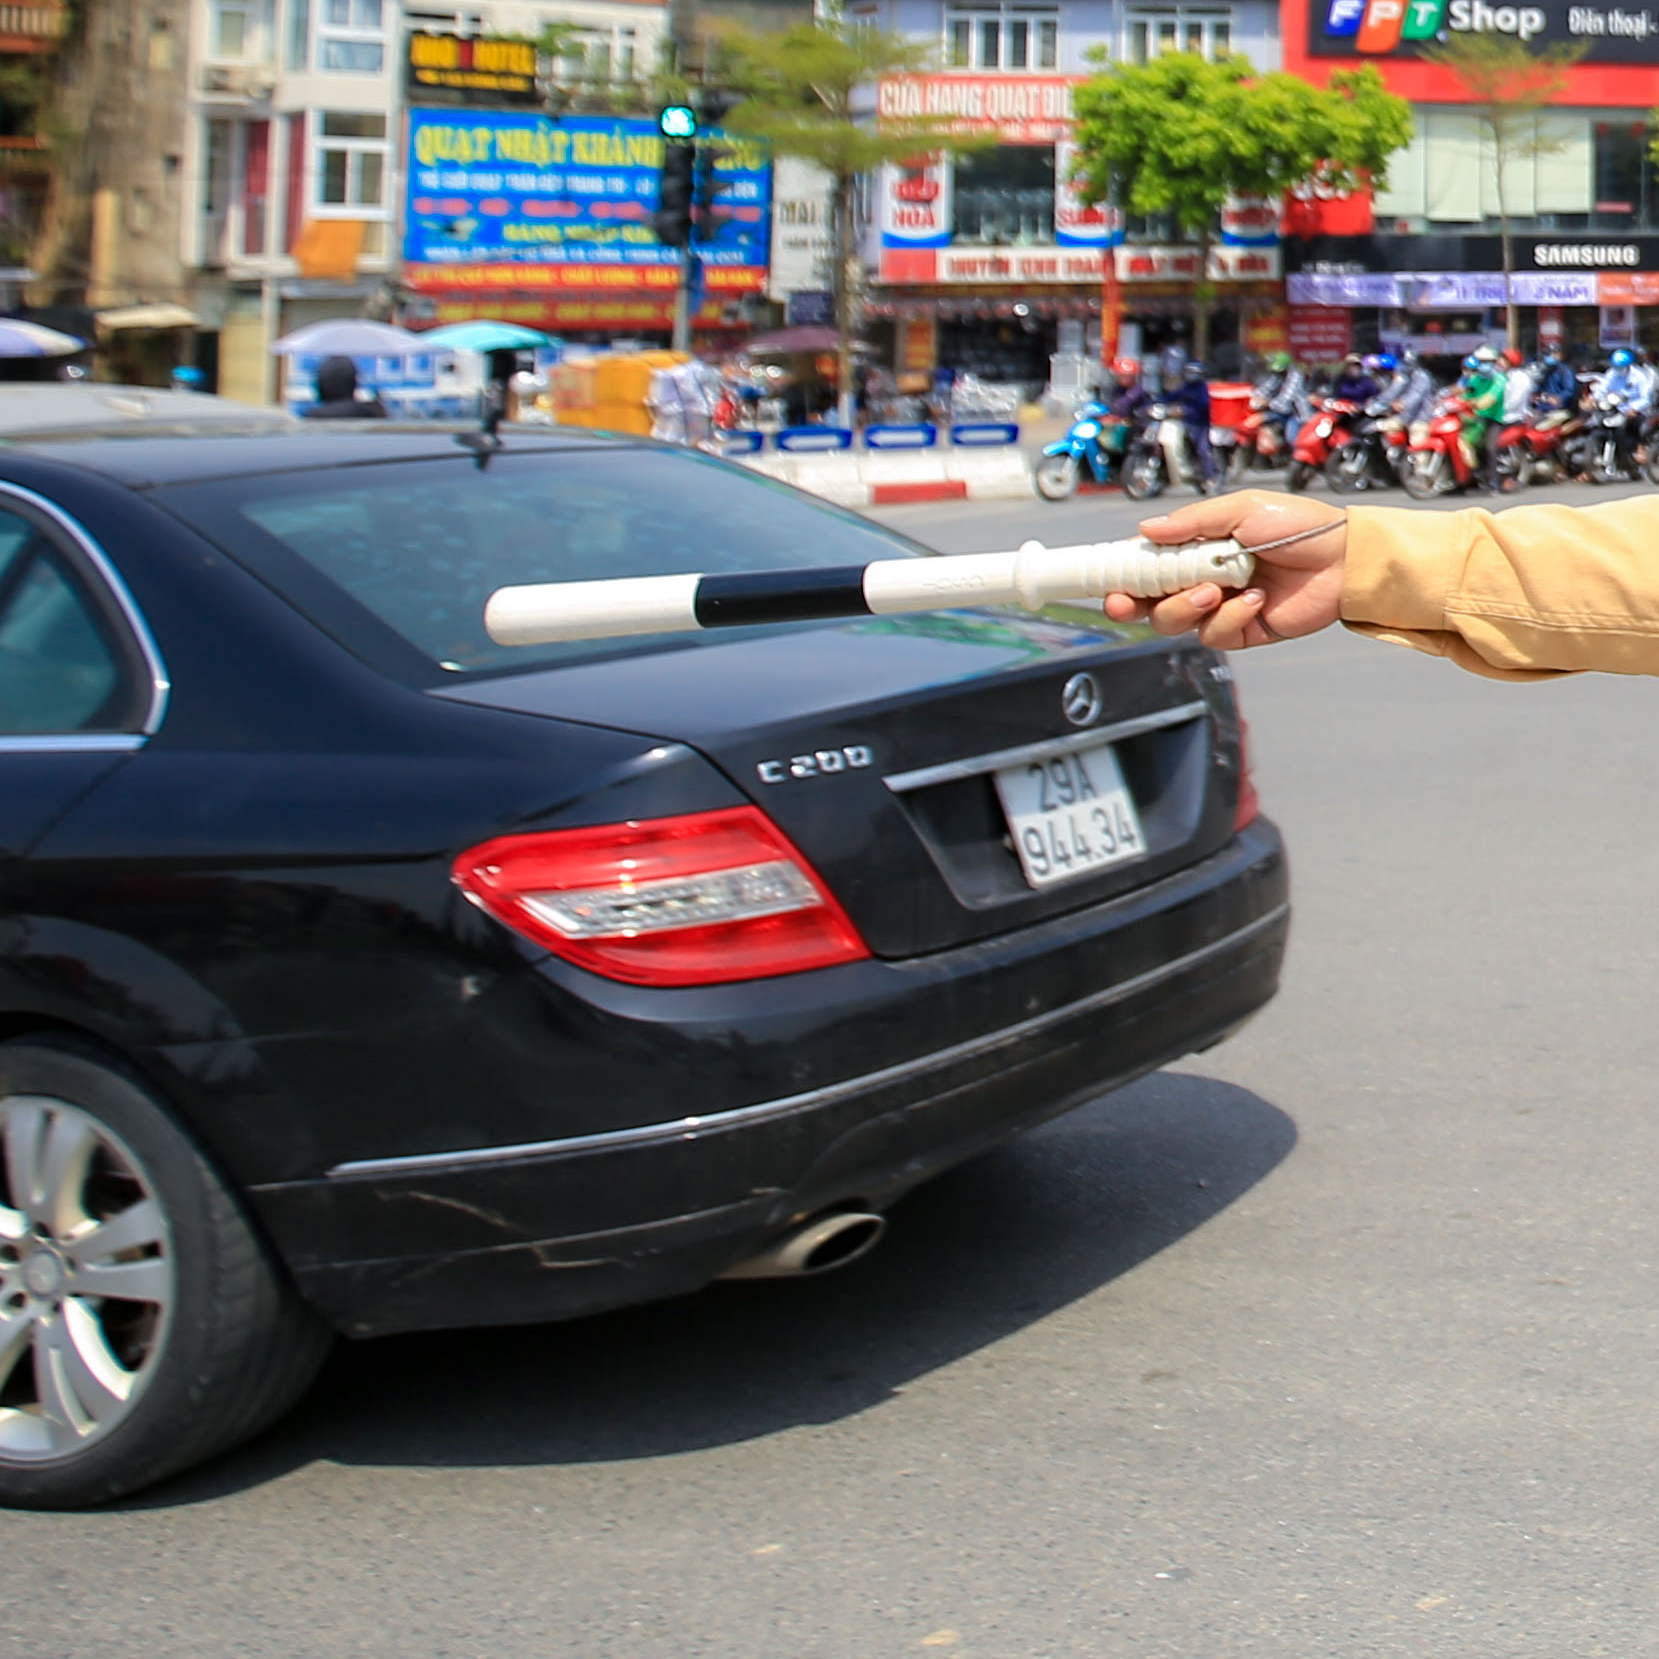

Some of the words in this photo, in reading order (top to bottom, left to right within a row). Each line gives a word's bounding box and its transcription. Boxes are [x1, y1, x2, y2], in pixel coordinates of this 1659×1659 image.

[1607, 6, 1648, 43] thoại
[985, 83, 1038, 123] QUẠT
[1532, 244, 1640, 267] SAMSUNG
[756, 760, 786, 783] C
[790, 744, 874, 778] 200
[1026, 751, 1099, 813] 29A
[1022, 802, 1137, 876] 944.34
